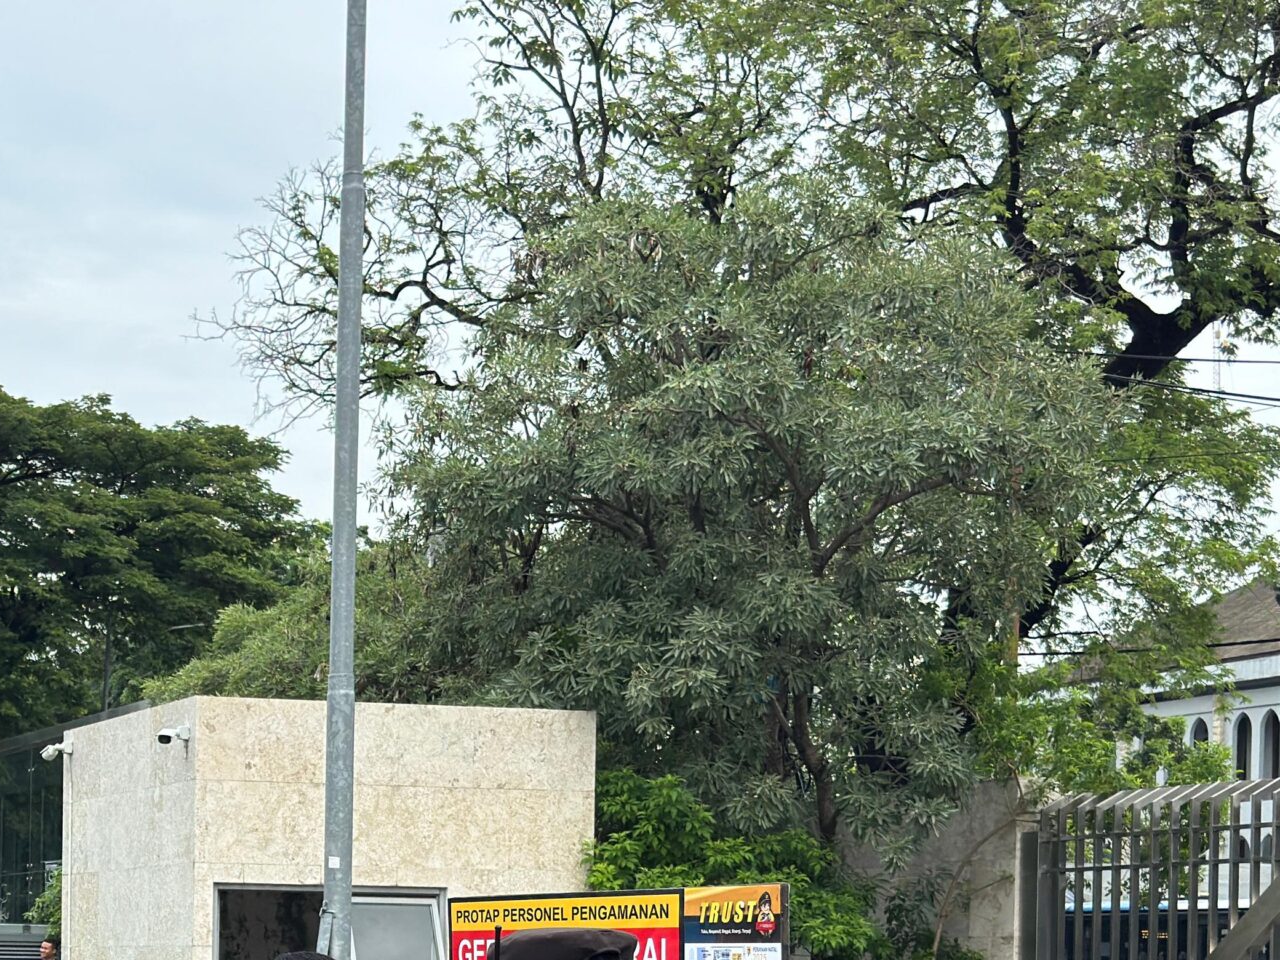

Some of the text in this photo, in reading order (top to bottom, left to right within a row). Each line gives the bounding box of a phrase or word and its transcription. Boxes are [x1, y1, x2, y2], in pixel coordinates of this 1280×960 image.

[456, 903, 670, 924] PROTAP PERSONEL PENGAMANAN
[700, 900, 757, 924] TRUST
